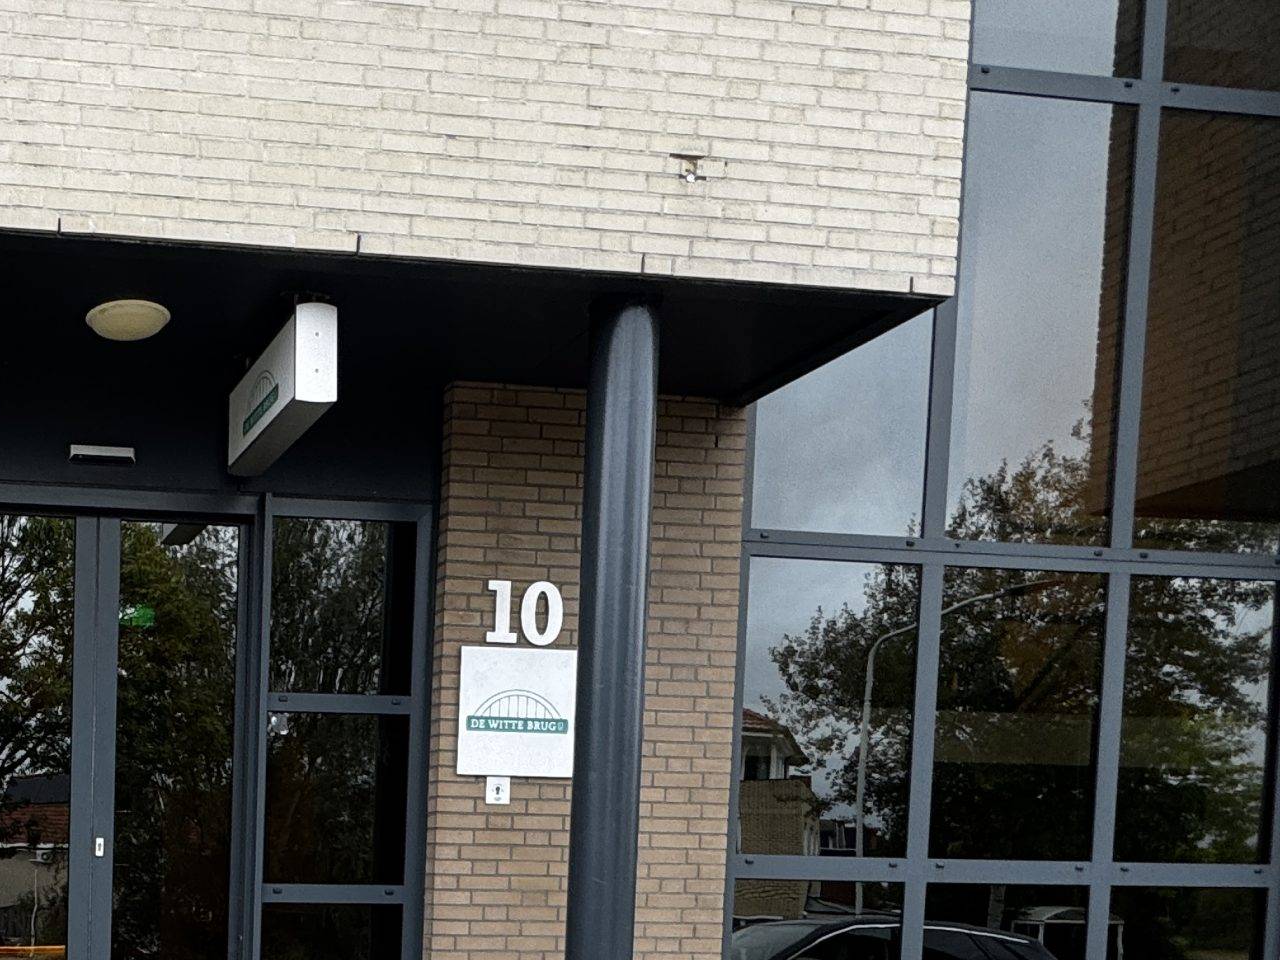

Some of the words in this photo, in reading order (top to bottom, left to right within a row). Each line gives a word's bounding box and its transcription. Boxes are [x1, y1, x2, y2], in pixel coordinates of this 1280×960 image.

[485, 580, 564, 646] 10
[470, 718, 486, 729] DE
[488, 719, 524, 730] WITTE
